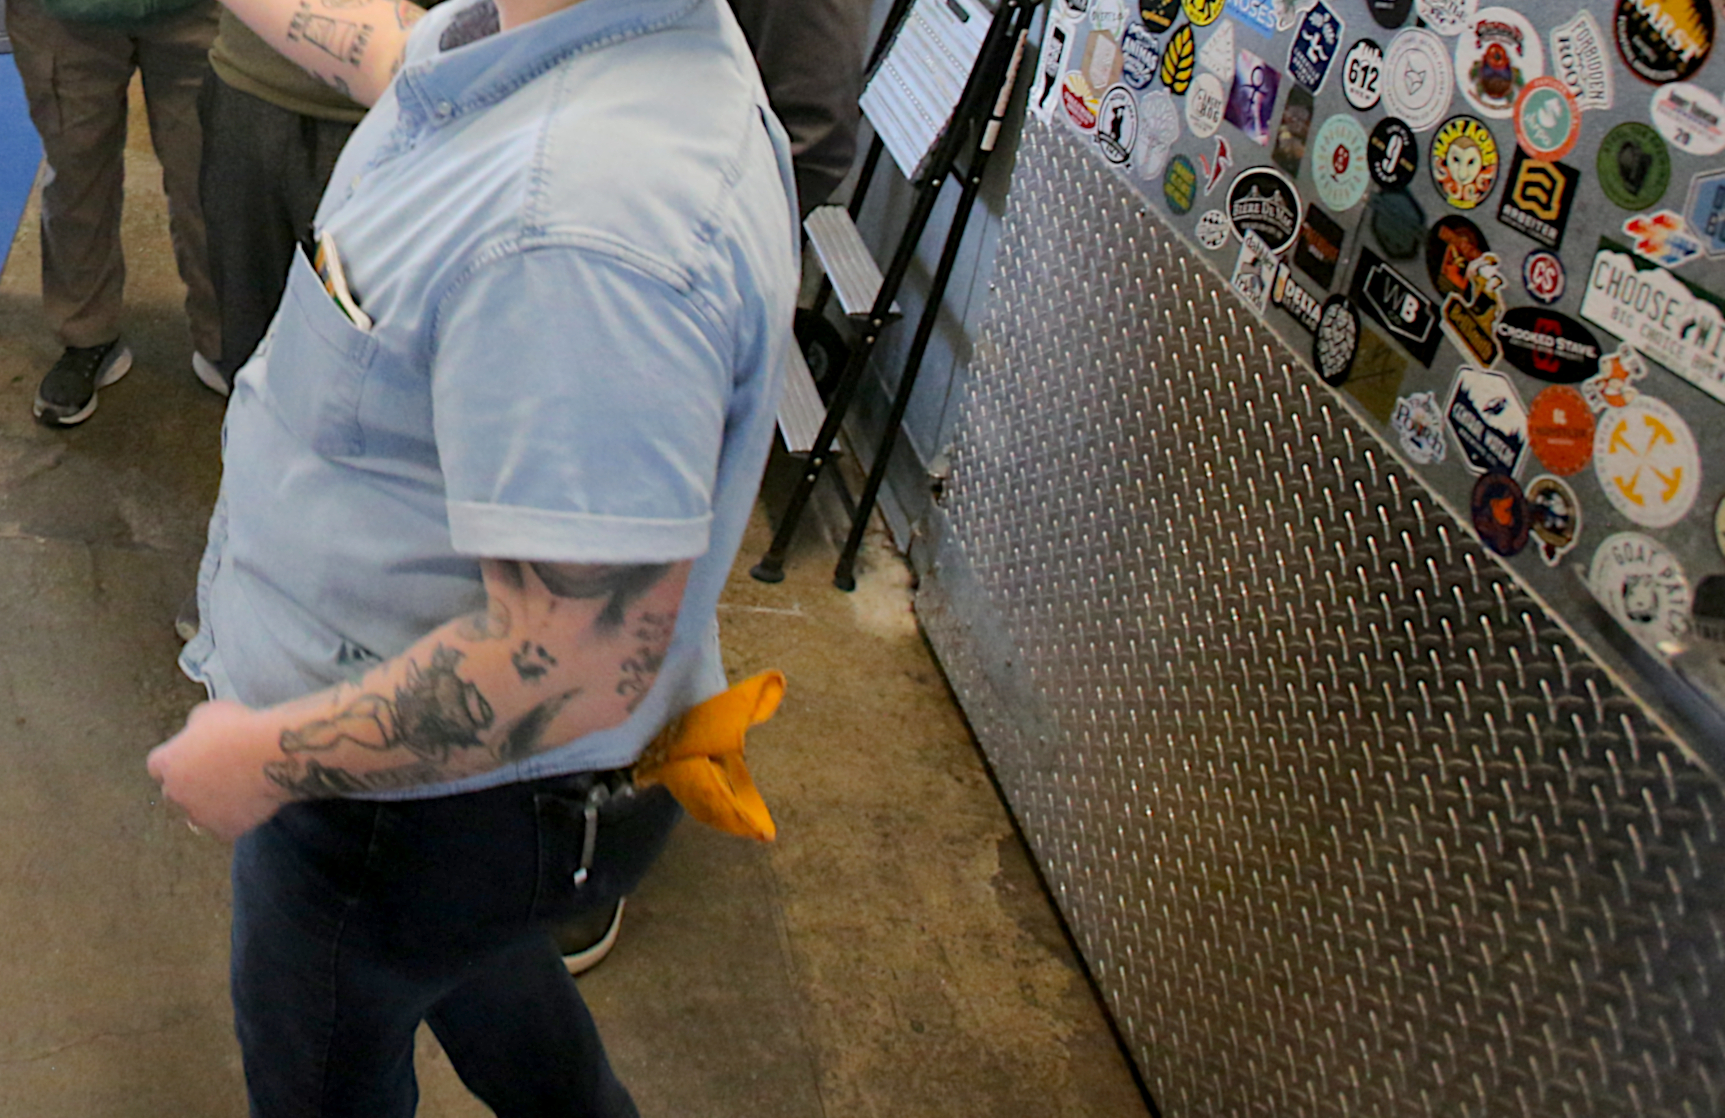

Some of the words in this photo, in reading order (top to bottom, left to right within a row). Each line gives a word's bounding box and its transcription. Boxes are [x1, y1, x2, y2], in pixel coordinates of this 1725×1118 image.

[1349, 59, 1379, 94] 612
[1558, 36, 1584, 99] ROOT
[1573, 20, 1606, 101] FORBIDDEN
[1433, 120, 1465, 160] HALF
[1465, 120, 1497, 167] ACRE
[1502, 204, 1559, 239] ARBEITER
[1285, 278, 1323, 323] DELTA
[1594, 260, 1679, 331] CHOOSE
[1497, 322, 1557, 349] CROOKED
[1556, 336, 1599, 360] STAVE
[1612, 541, 1657, 566] GOAT
